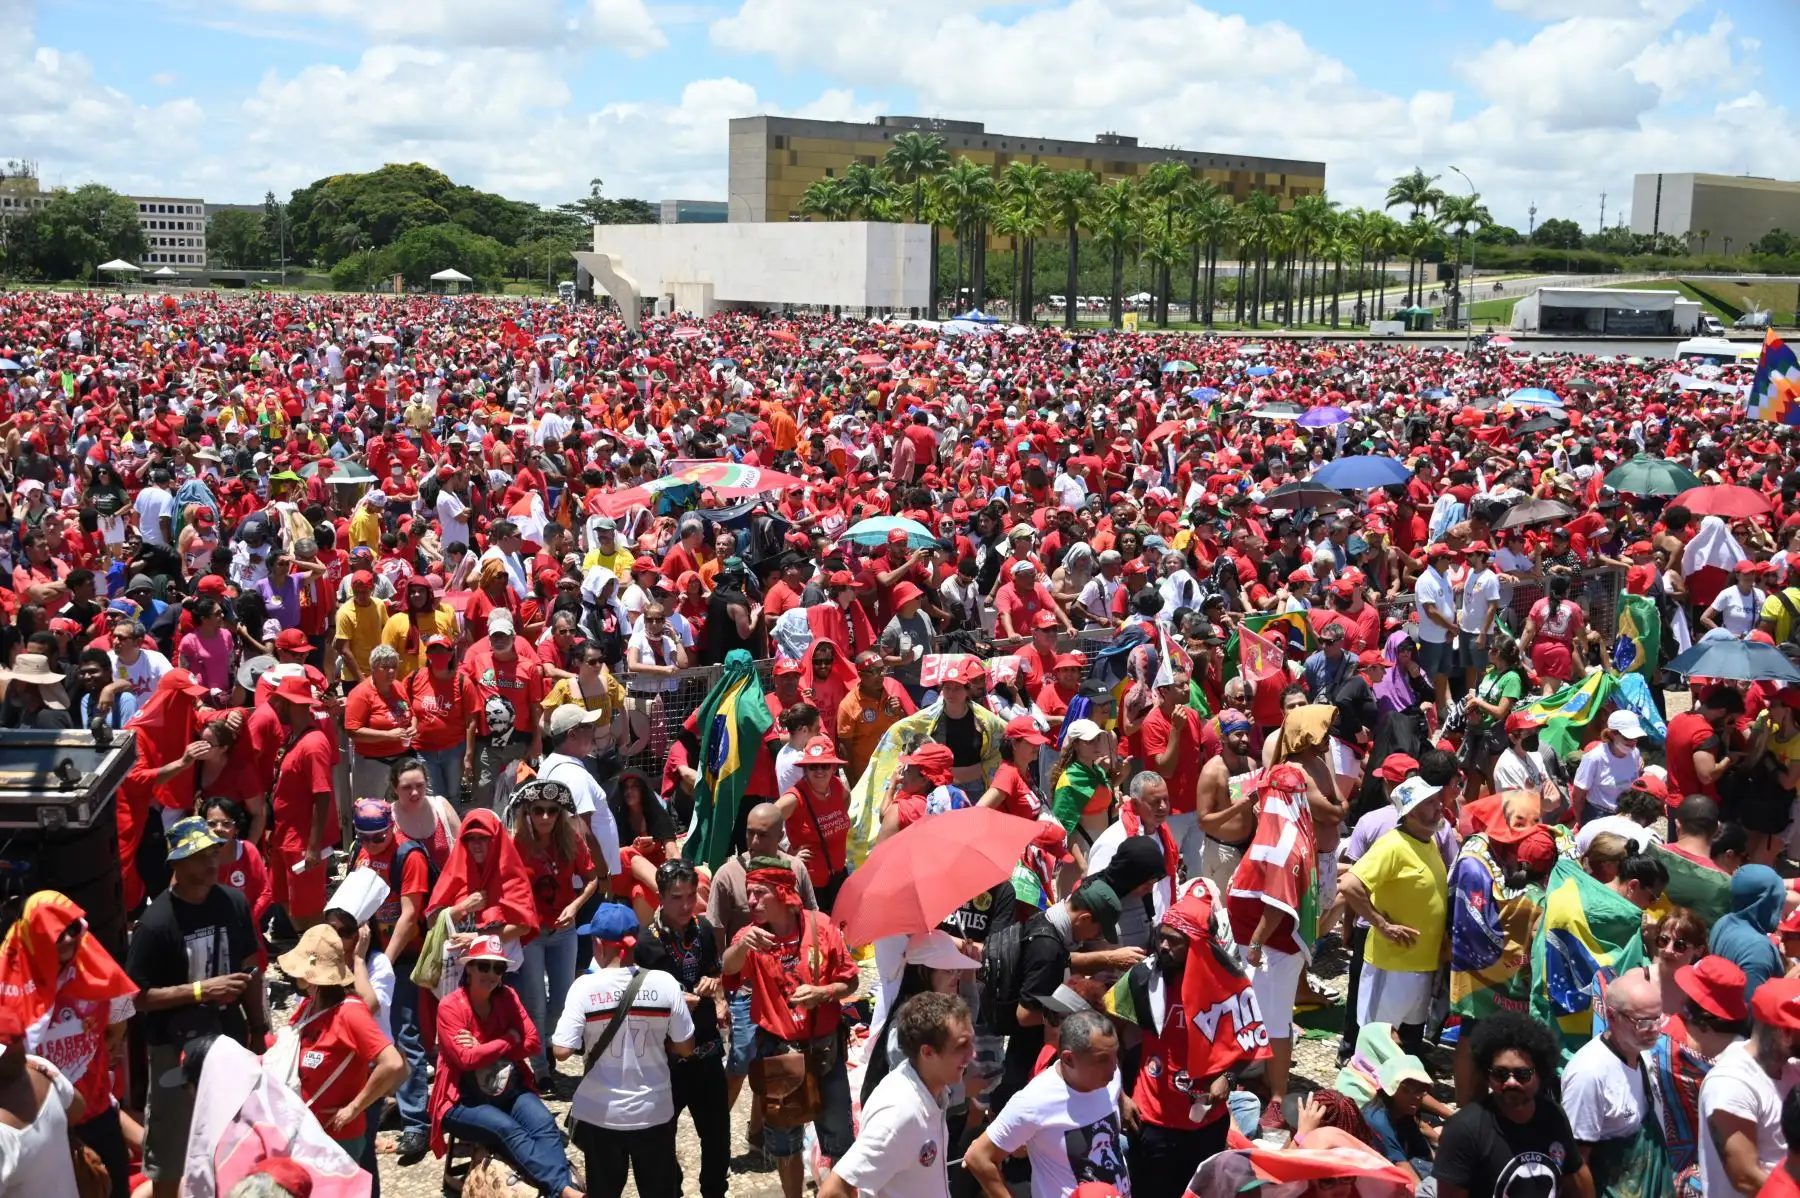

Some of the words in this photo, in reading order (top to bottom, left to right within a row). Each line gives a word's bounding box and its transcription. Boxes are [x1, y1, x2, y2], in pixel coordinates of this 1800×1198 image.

[782, 661, 798, 669] LULA
[943, 910, 988, 931] EATLES
[589, 989, 659, 1007] FLASIRO
[1520, 1153, 1543, 1164] AÇÃO
